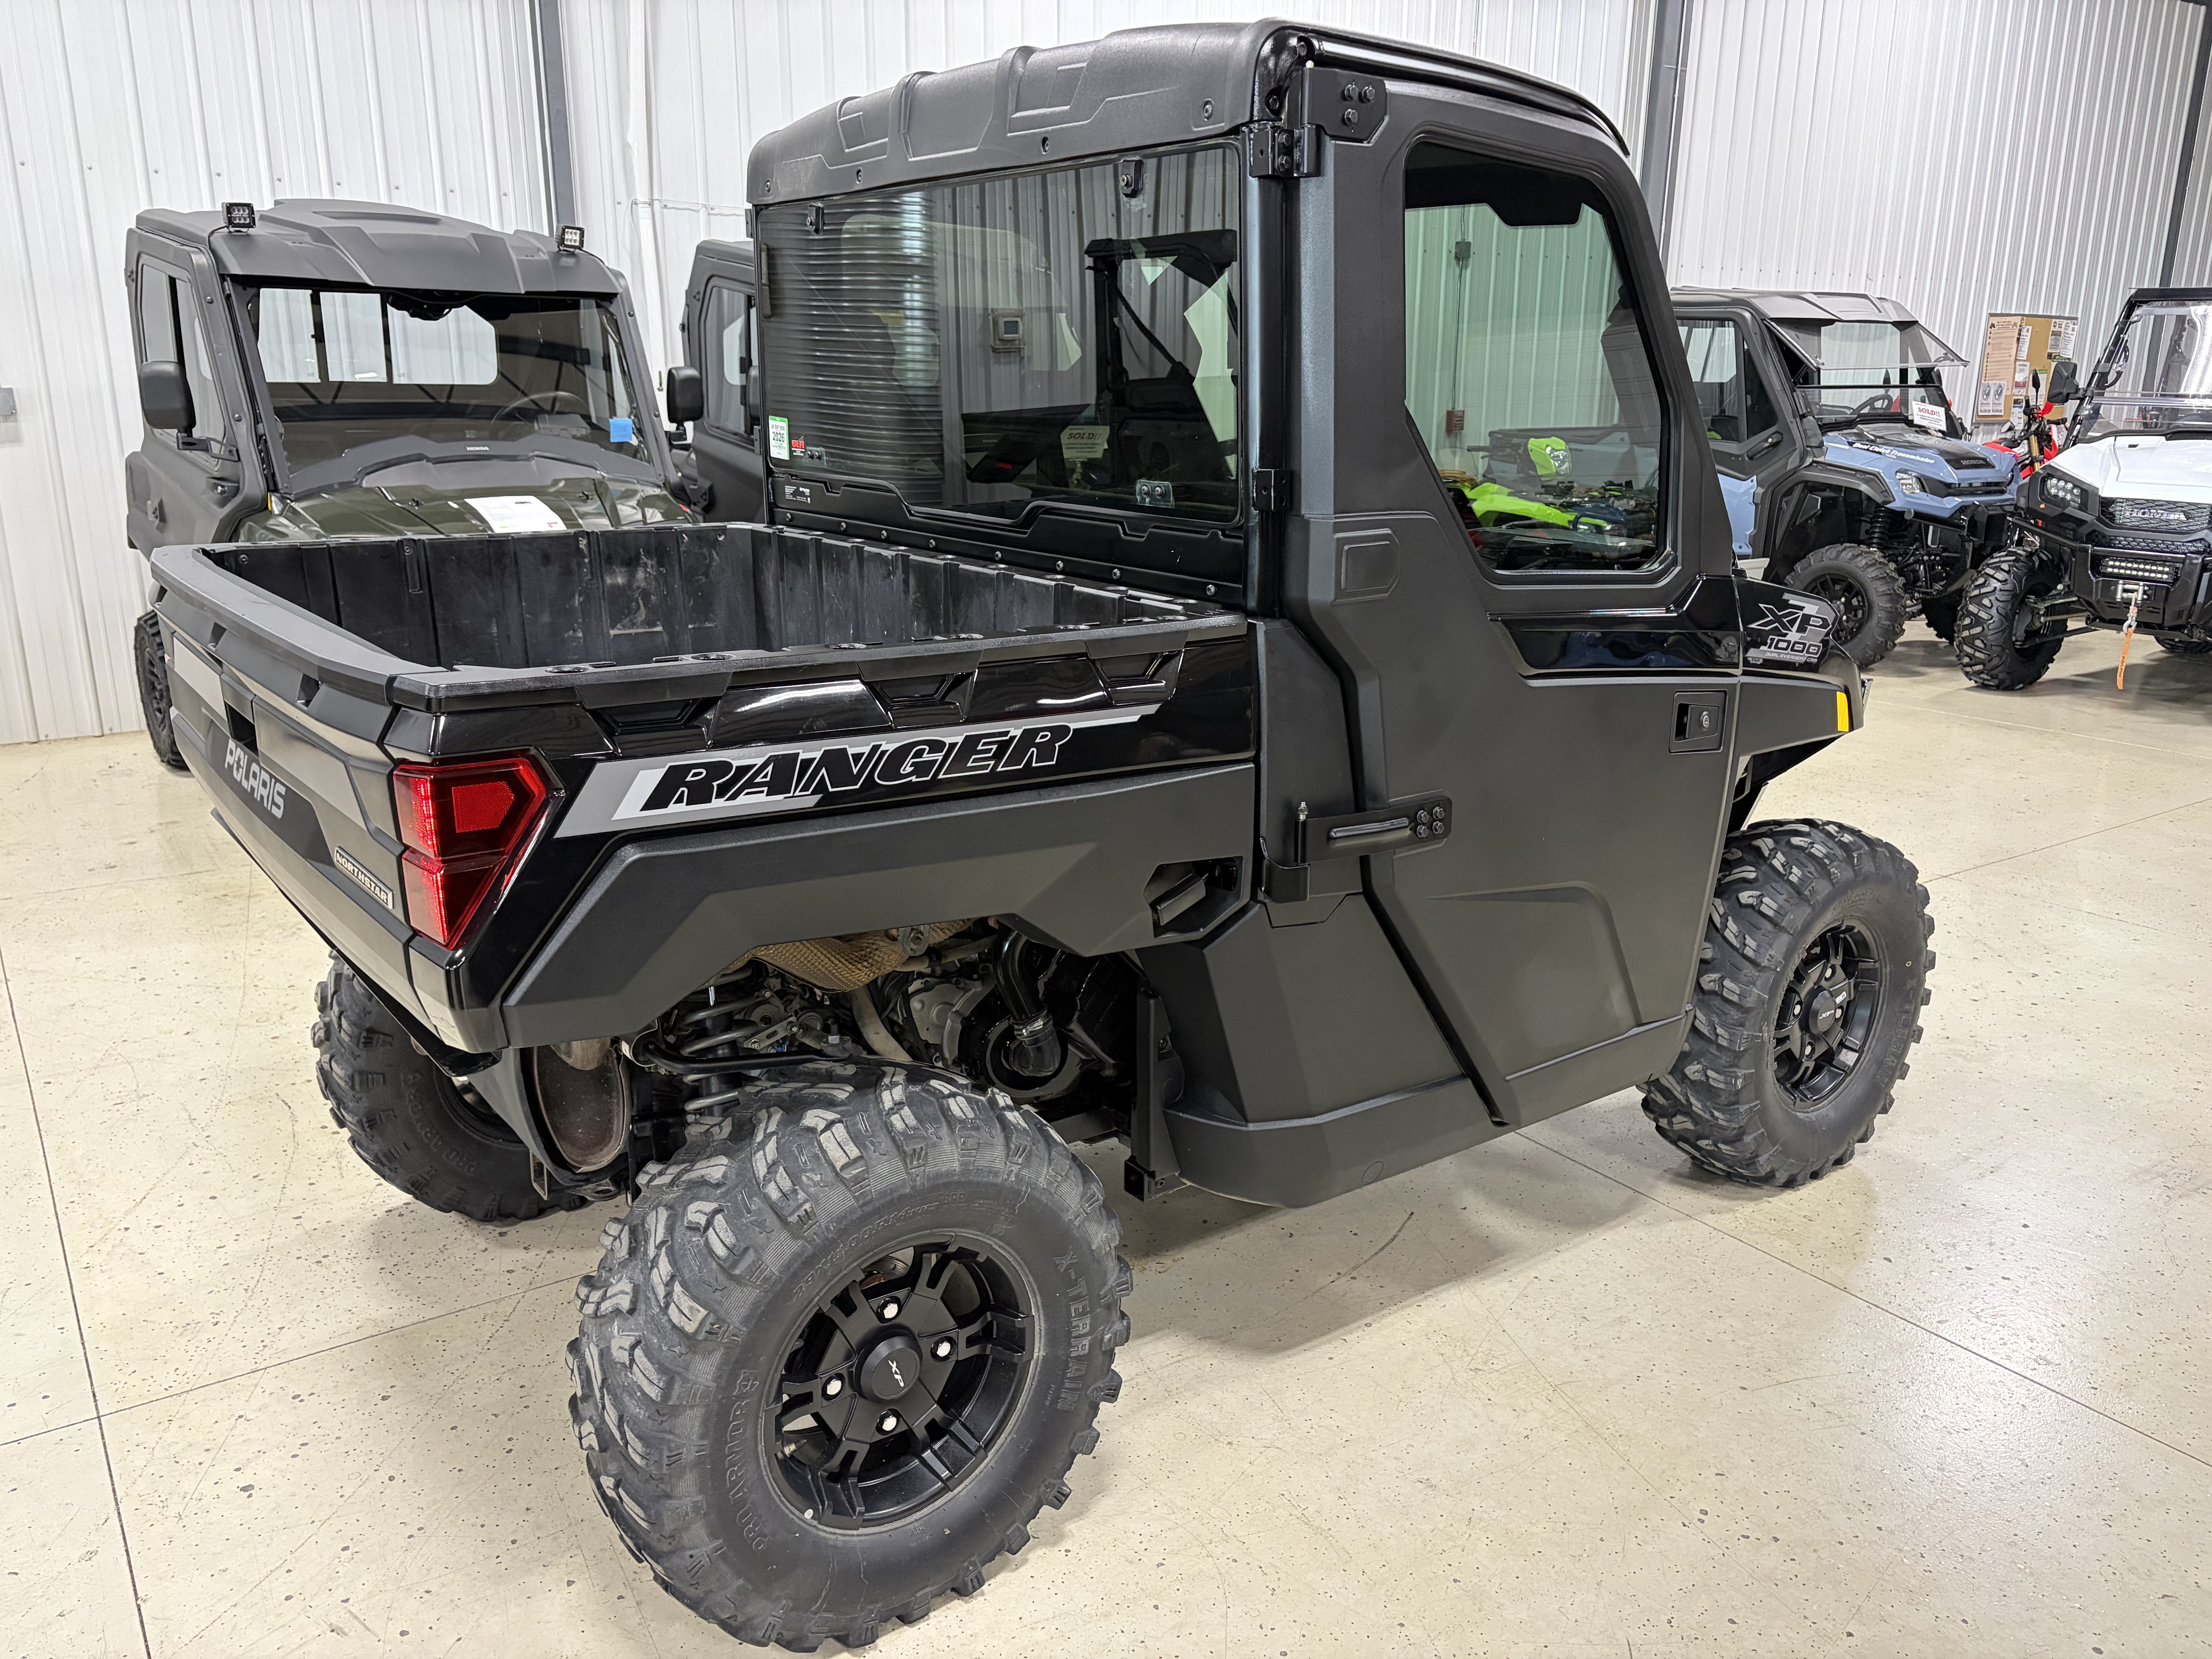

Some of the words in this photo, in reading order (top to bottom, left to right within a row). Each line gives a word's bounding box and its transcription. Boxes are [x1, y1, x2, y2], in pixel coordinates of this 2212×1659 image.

[1918, 407, 1940, 417] SOLD!!
[773, 431, 785, 442] 2026
[1891, 450, 1935, 464] Transmission
[1747, 603, 1832, 636] XP
[1767, 635, 1822, 658] 1000
[225, 738, 286, 819] POLARIS
[639, 724, 1073, 812] RANGER
[337, 852, 388, 903] NORTHSTAR
[1819, 1010, 1834, 1019] XP
[1874, 977, 1917, 1088] X-TERRAIN
[1053, 1245, 1091, 1412] X-TERRAIN
[888, 1360, 904, 1387] XP
[726, 1399, 752, 1505] ARMOR
[736, 1504, 773, 1553] PRO
